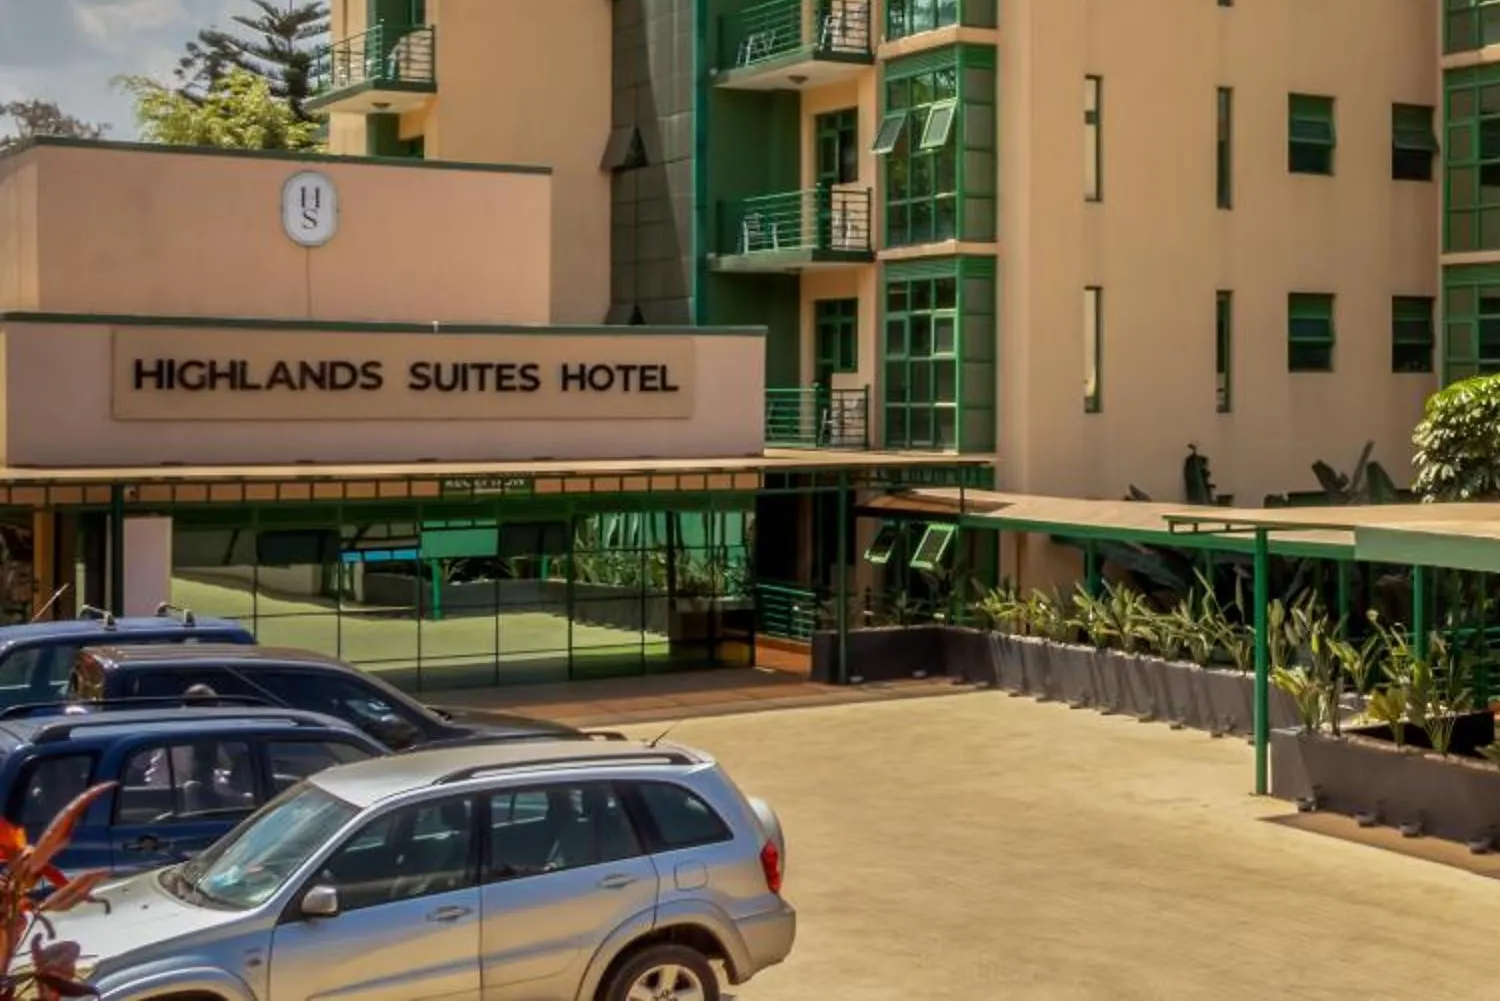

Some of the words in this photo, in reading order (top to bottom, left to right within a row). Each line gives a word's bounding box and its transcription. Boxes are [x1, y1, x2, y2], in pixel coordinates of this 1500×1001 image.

[134, 358, 384, 392] HIGHLANDS
[408, 361, 541, 392] SUITES
[561, 363, 679, 393] HOTEL
